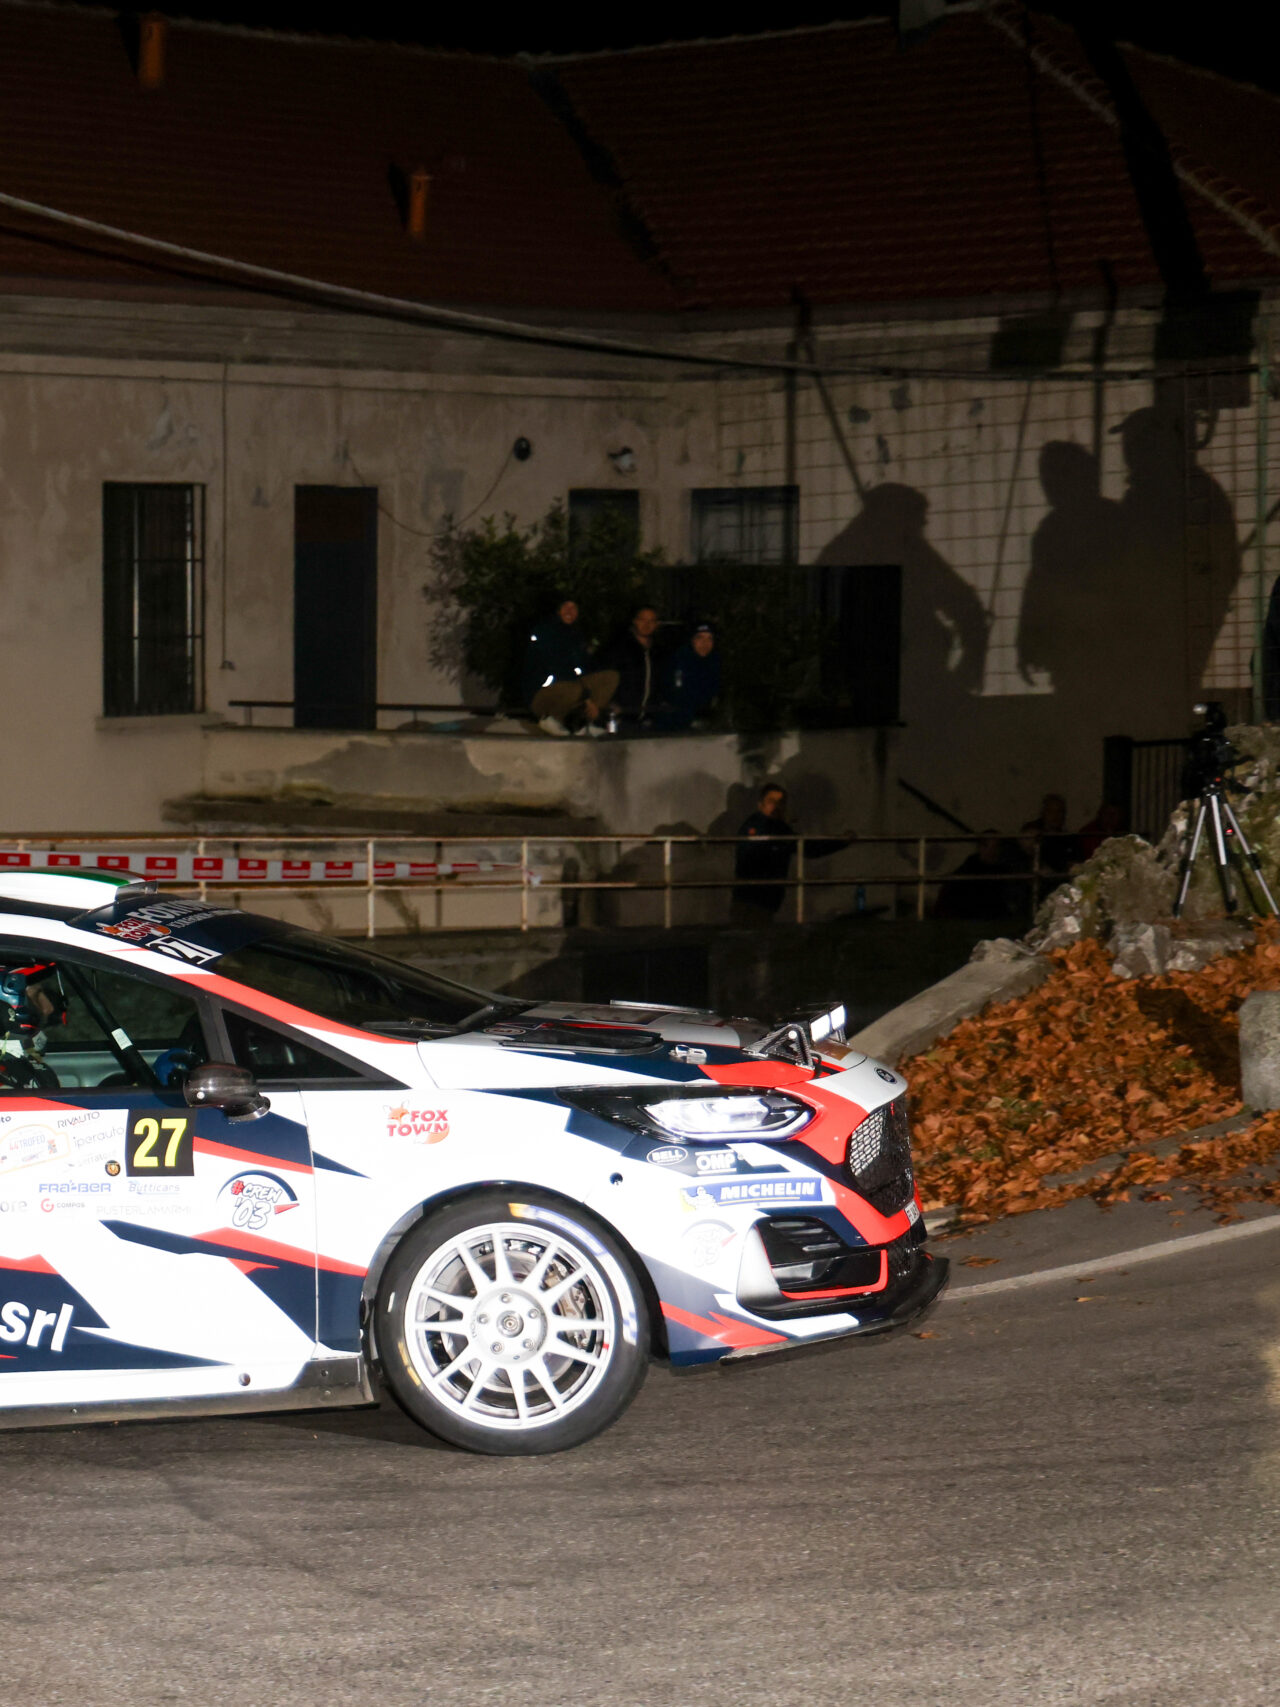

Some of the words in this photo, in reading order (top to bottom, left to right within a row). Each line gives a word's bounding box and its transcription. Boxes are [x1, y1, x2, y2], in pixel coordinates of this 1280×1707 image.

[57, 1111, 100, 1128] RIVAUTO
[410, 1109, 448, 1122] FOX
[73, 1126, 124, 1150] iperauto
[387, 1123, 448, 1137] TOWN
[133, 1118, 187, 1167] 27
[651, 1150, 683, 1161] BELL
[696, 1152, 736, 1171] OMP
[720, 1182, 816, 1201] MICHELIN
